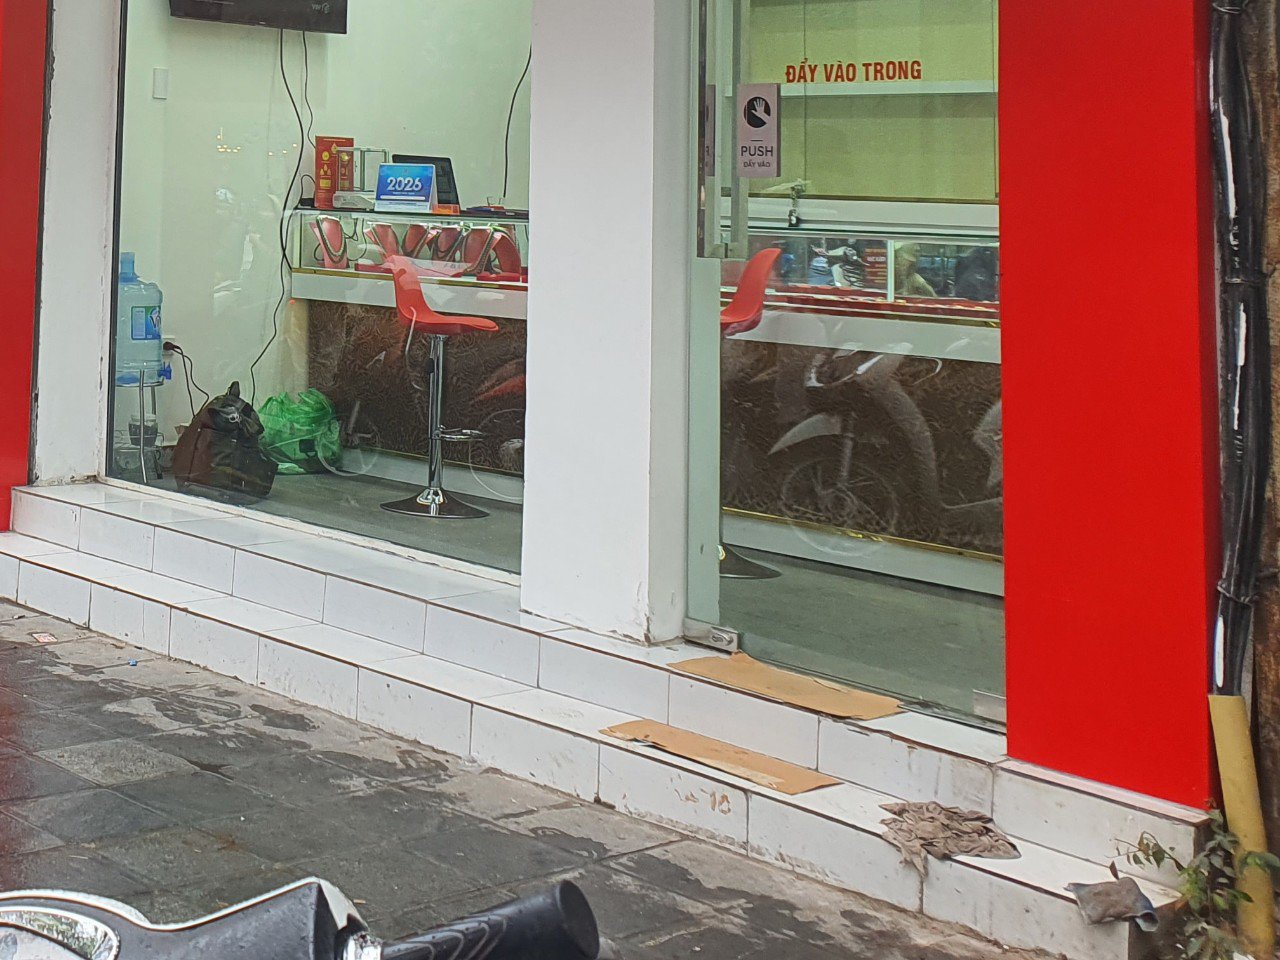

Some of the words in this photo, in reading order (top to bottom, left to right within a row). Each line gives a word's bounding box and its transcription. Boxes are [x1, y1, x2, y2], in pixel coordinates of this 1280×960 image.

[785, 57, 818, 84] ĐẨY
[824, 60, 857, 82] VÀO
[862, 60, 922, 81] TRONG
[740, 146, 774, 157] PUSH
[386, 176, 423, 191] 2026
